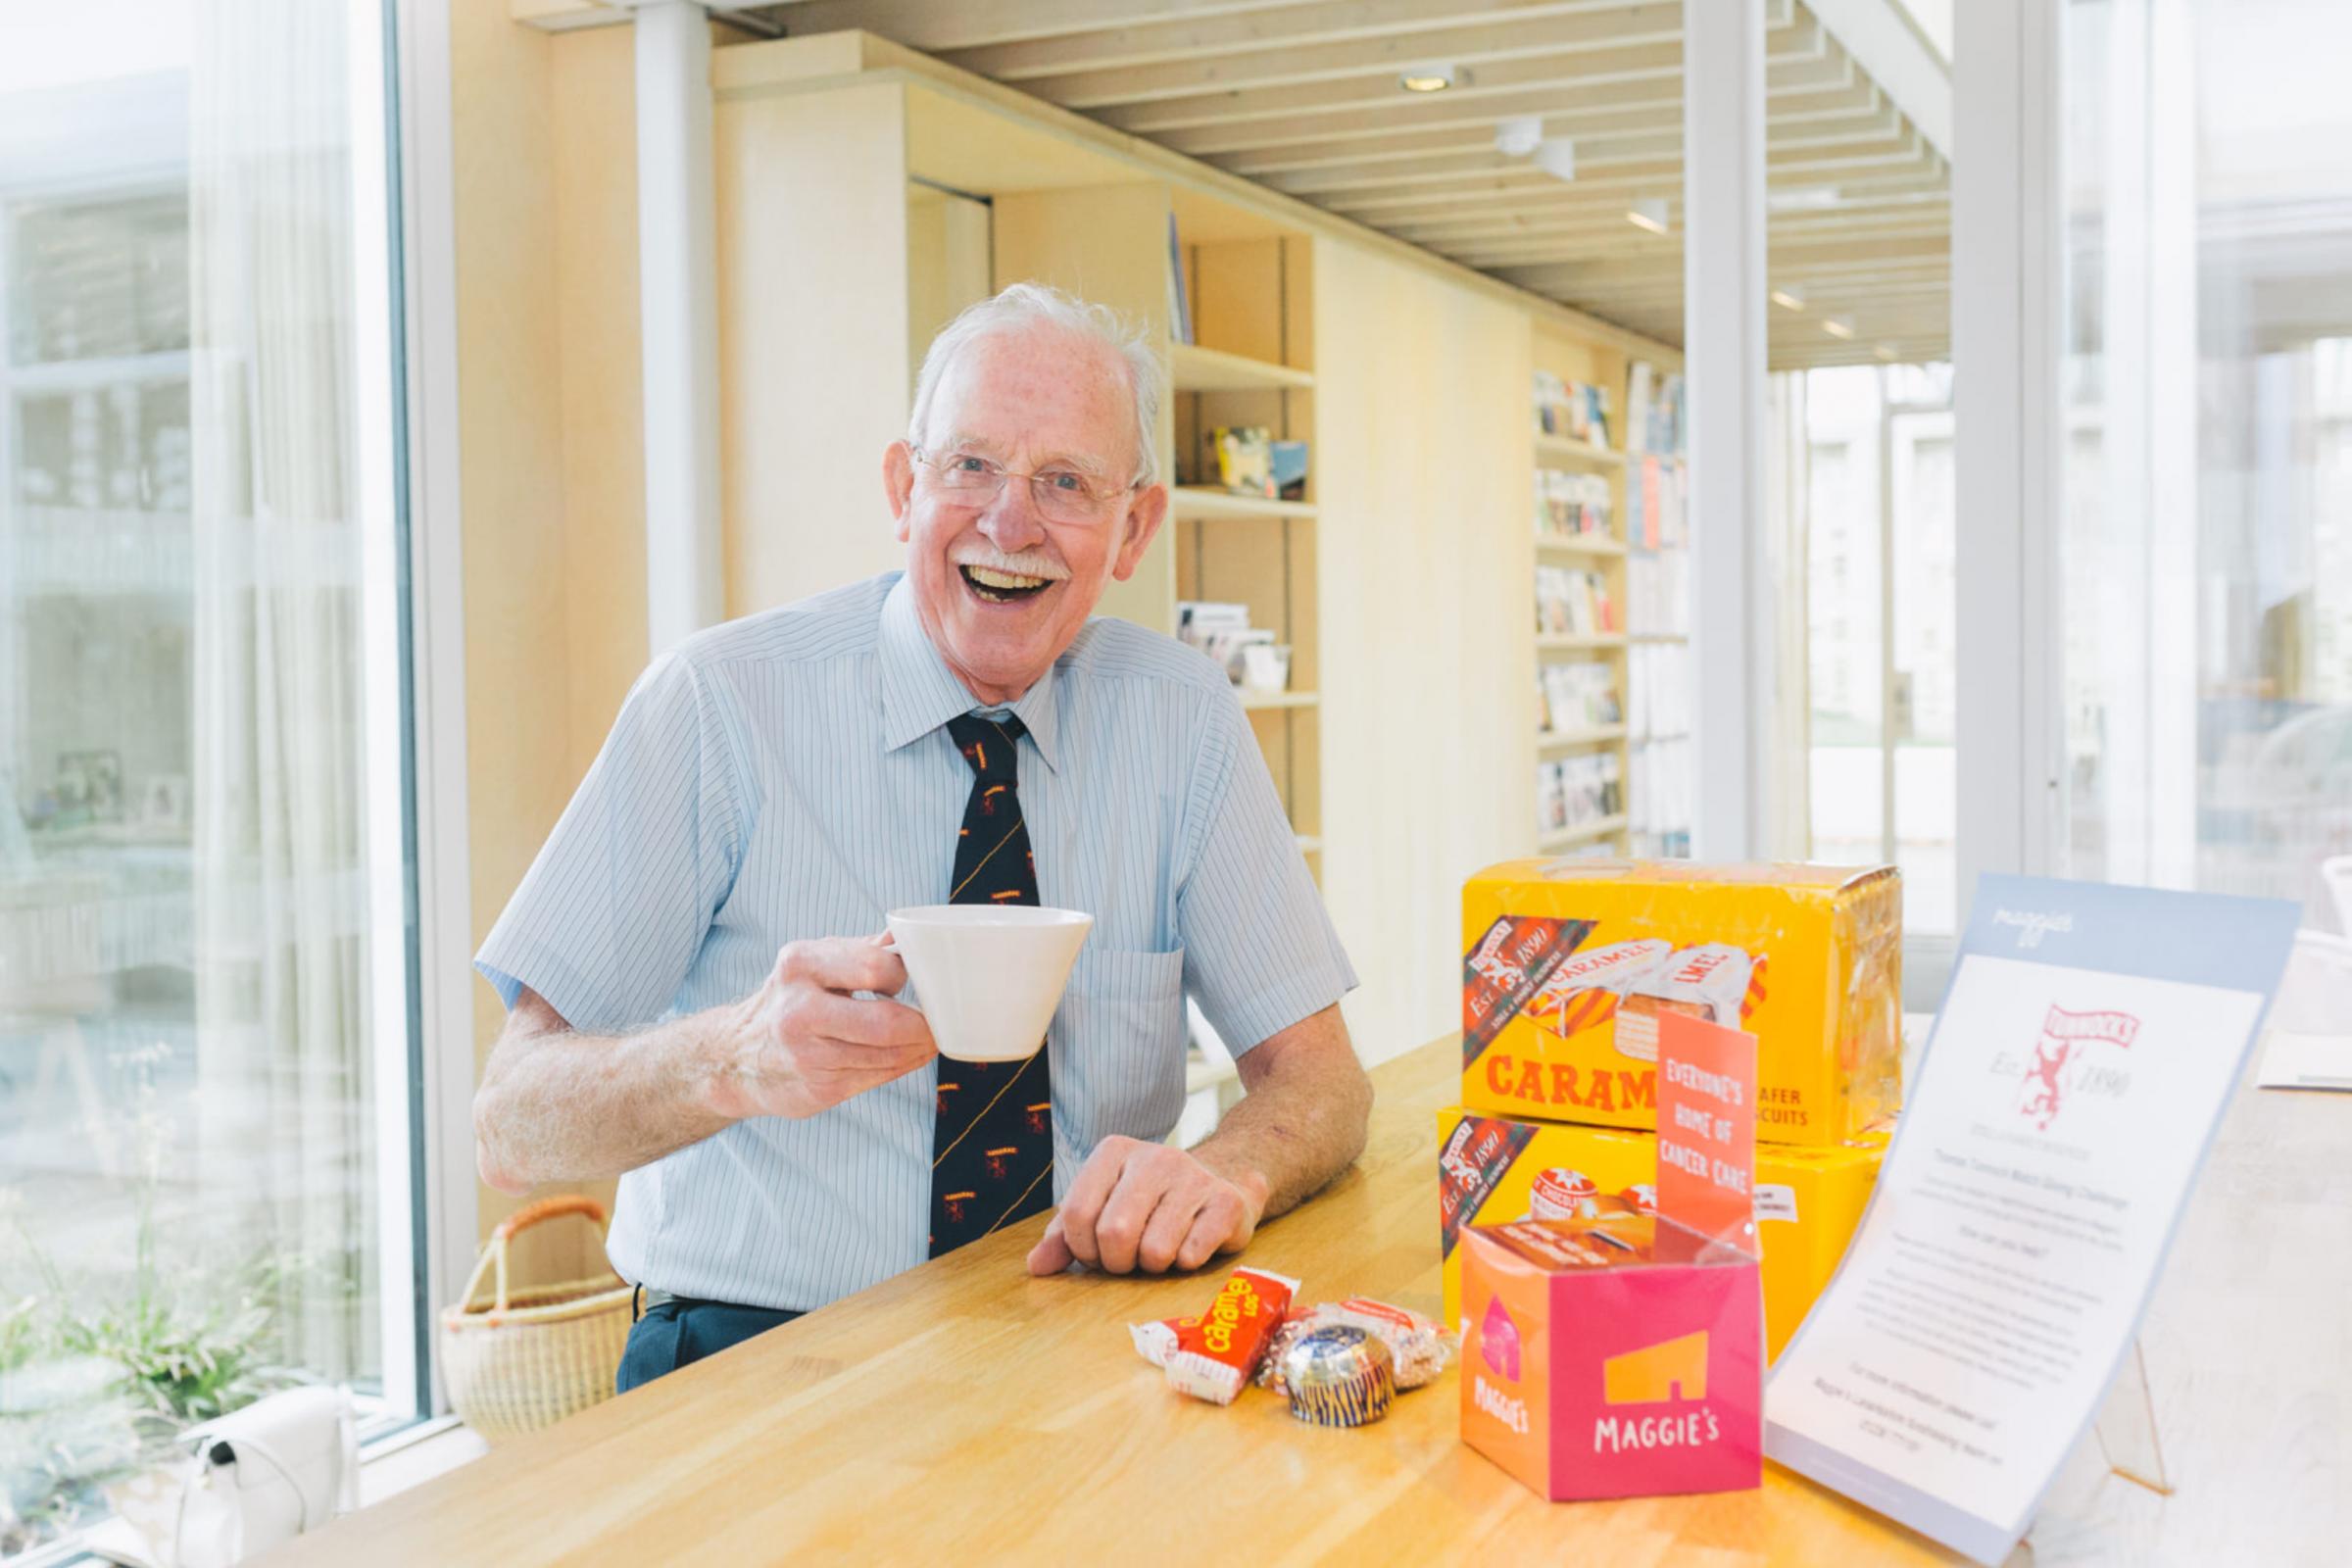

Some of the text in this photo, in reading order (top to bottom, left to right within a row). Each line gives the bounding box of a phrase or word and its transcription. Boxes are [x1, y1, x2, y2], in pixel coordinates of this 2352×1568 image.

[1548, 944, 1654, 983] CARAMEL
[1675, 1102, 1733, 1145] HOME OF
[1660, 1139, 1748, 1196] CANCER CARE
[1244, 1294, 1259, 1317] LOG
[1473, 1376, 1529, 1435] MAGGIE'S
[1593, 1407, 1720, 1453] MAGGIE'S
